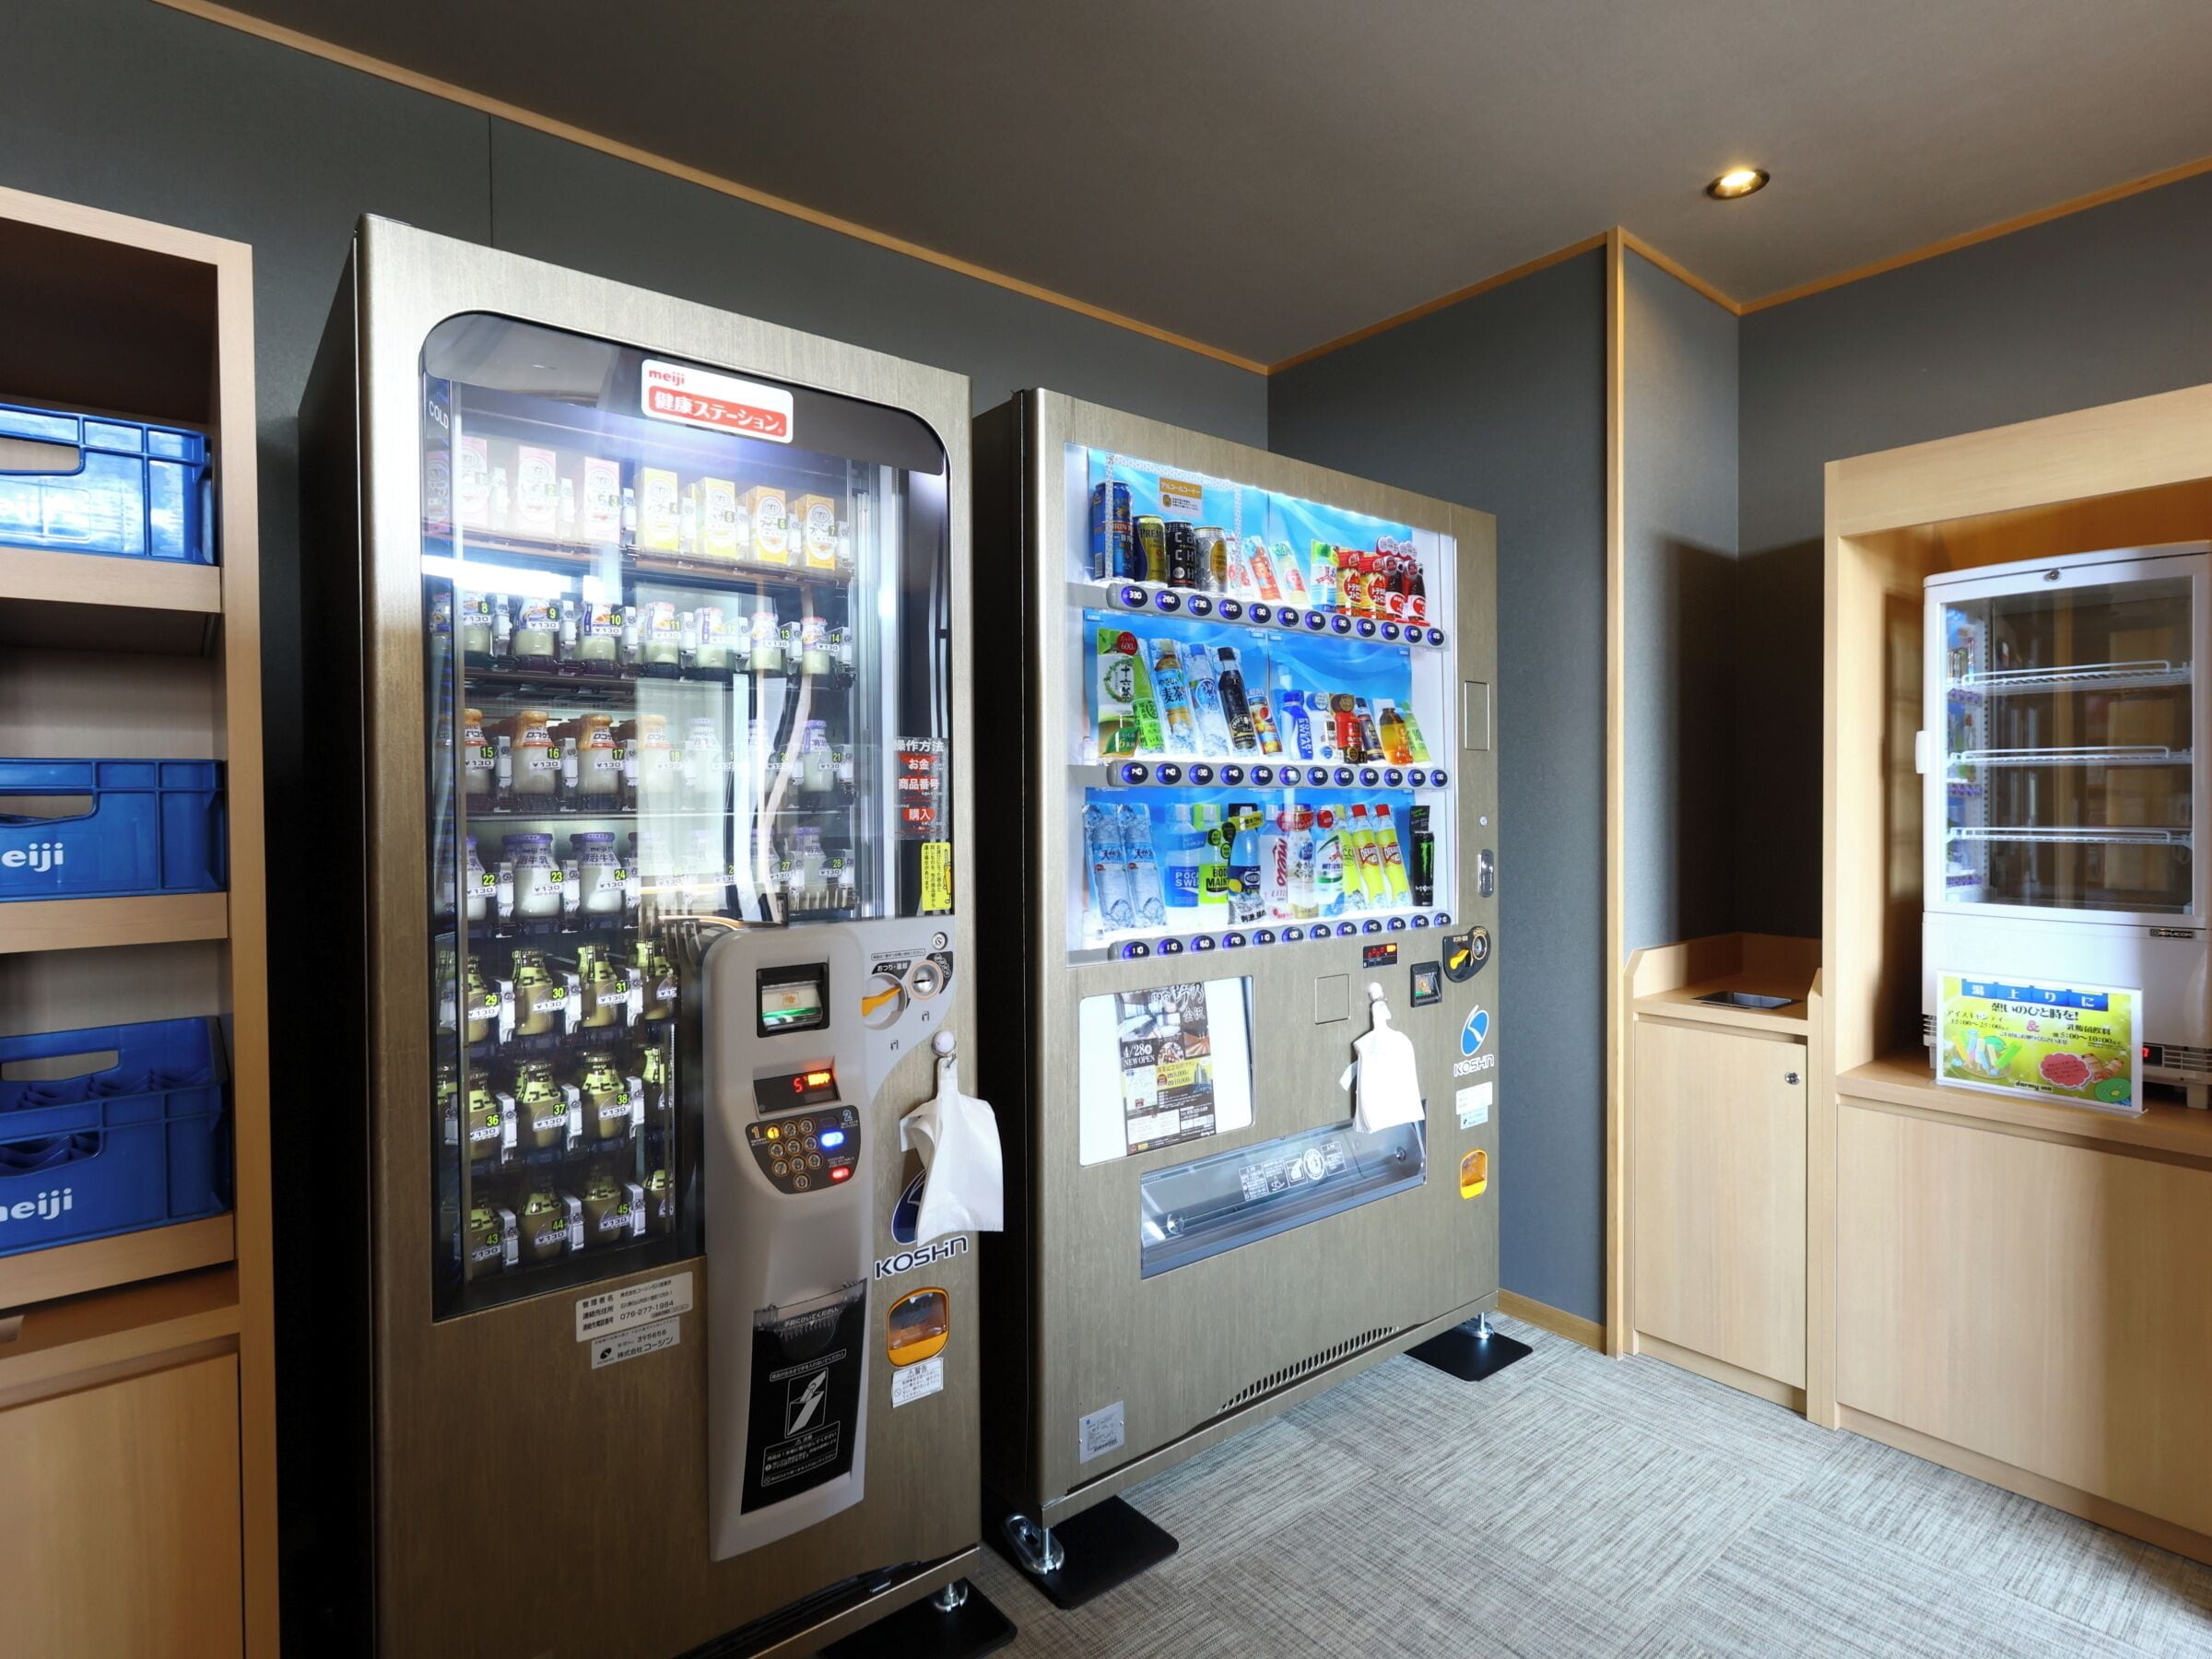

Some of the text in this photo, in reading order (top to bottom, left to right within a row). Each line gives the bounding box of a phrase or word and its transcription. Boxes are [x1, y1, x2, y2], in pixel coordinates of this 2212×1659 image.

[649, 370, 685, 386] meiji
[429, 400, 449, 429] COLD
[655, 391, 780, 432] 健康ステーション
[480, 601, 488, 613] 8
[549, 608, 557, 619] 9
[530, 621, 557, 629] ¥130
[610, 614, 621, 625] 10
[671, 620, 680, 630] 11
[781, 629, 790, 640] 13
[831, 633, 841, 643] 14
[1119, 665, 1133, 702] 十六茶
[1163, 685, 1185, 703] 麦茶
[1298, 716, 1307, 750] SWEAT
[892, 739, 945, 752] 操作方法
[481, 747, 493, 759] 15
[547, 747, 559, 759] 16
[613, 748, 624, 759] 17
[671, 752, 680, 762] 18
[833, 752, 841, 762] 21
[465, 759, 492, 768] ¥130
[908, 758, 930, 771] お金
[898, 778, 940, 790] 商品番号
[908, 808, 931, 821] 購入
[0, 841, 64, 873] eiji
[782, 861, 790, 871] 27
[833, 859, 841, 868] 28
[482, 874, 495, 886] 22
[551, 871, 563, 883] 23
[615, 869, 626, 880] 24
[467, 887, 493, 895] ¥130
[616, 981, 627, 992] 31
[553, 987, 564, 998] 30
[485, 994, 498, 1006] 29
[600, 994, 625, 1003] ¥130
[536, 1001, 562, 1009] ¥130
[2026, 1020, 2041, 1033] &
[2066, 1023, 2111, 1036] 乳酸菌飲料
[1124, 1054, 1156, 1066] NEW OPEN
[2015, 1080, 2040, 1091] dormy
[617, 1093, 628, 1105] 38
[554, 1104, 565, 1115] 37
[602, 1106, 627, 1116] ¥130
[486, 1114, 499, 1126] 36
[842, 1109, 853, 1122] 2
[536, 1118, 562, 1128] ¥130
[469, 1128, 496, 1138] ¥130
[751, 1125, 760, 1139] 1
[618, 1204, 629, 1215] 45
[552, 1219, 564, 1231] 44
[603, 1217, 628, 1227] ¥130
[486, 1233, 499, 1244] 43
